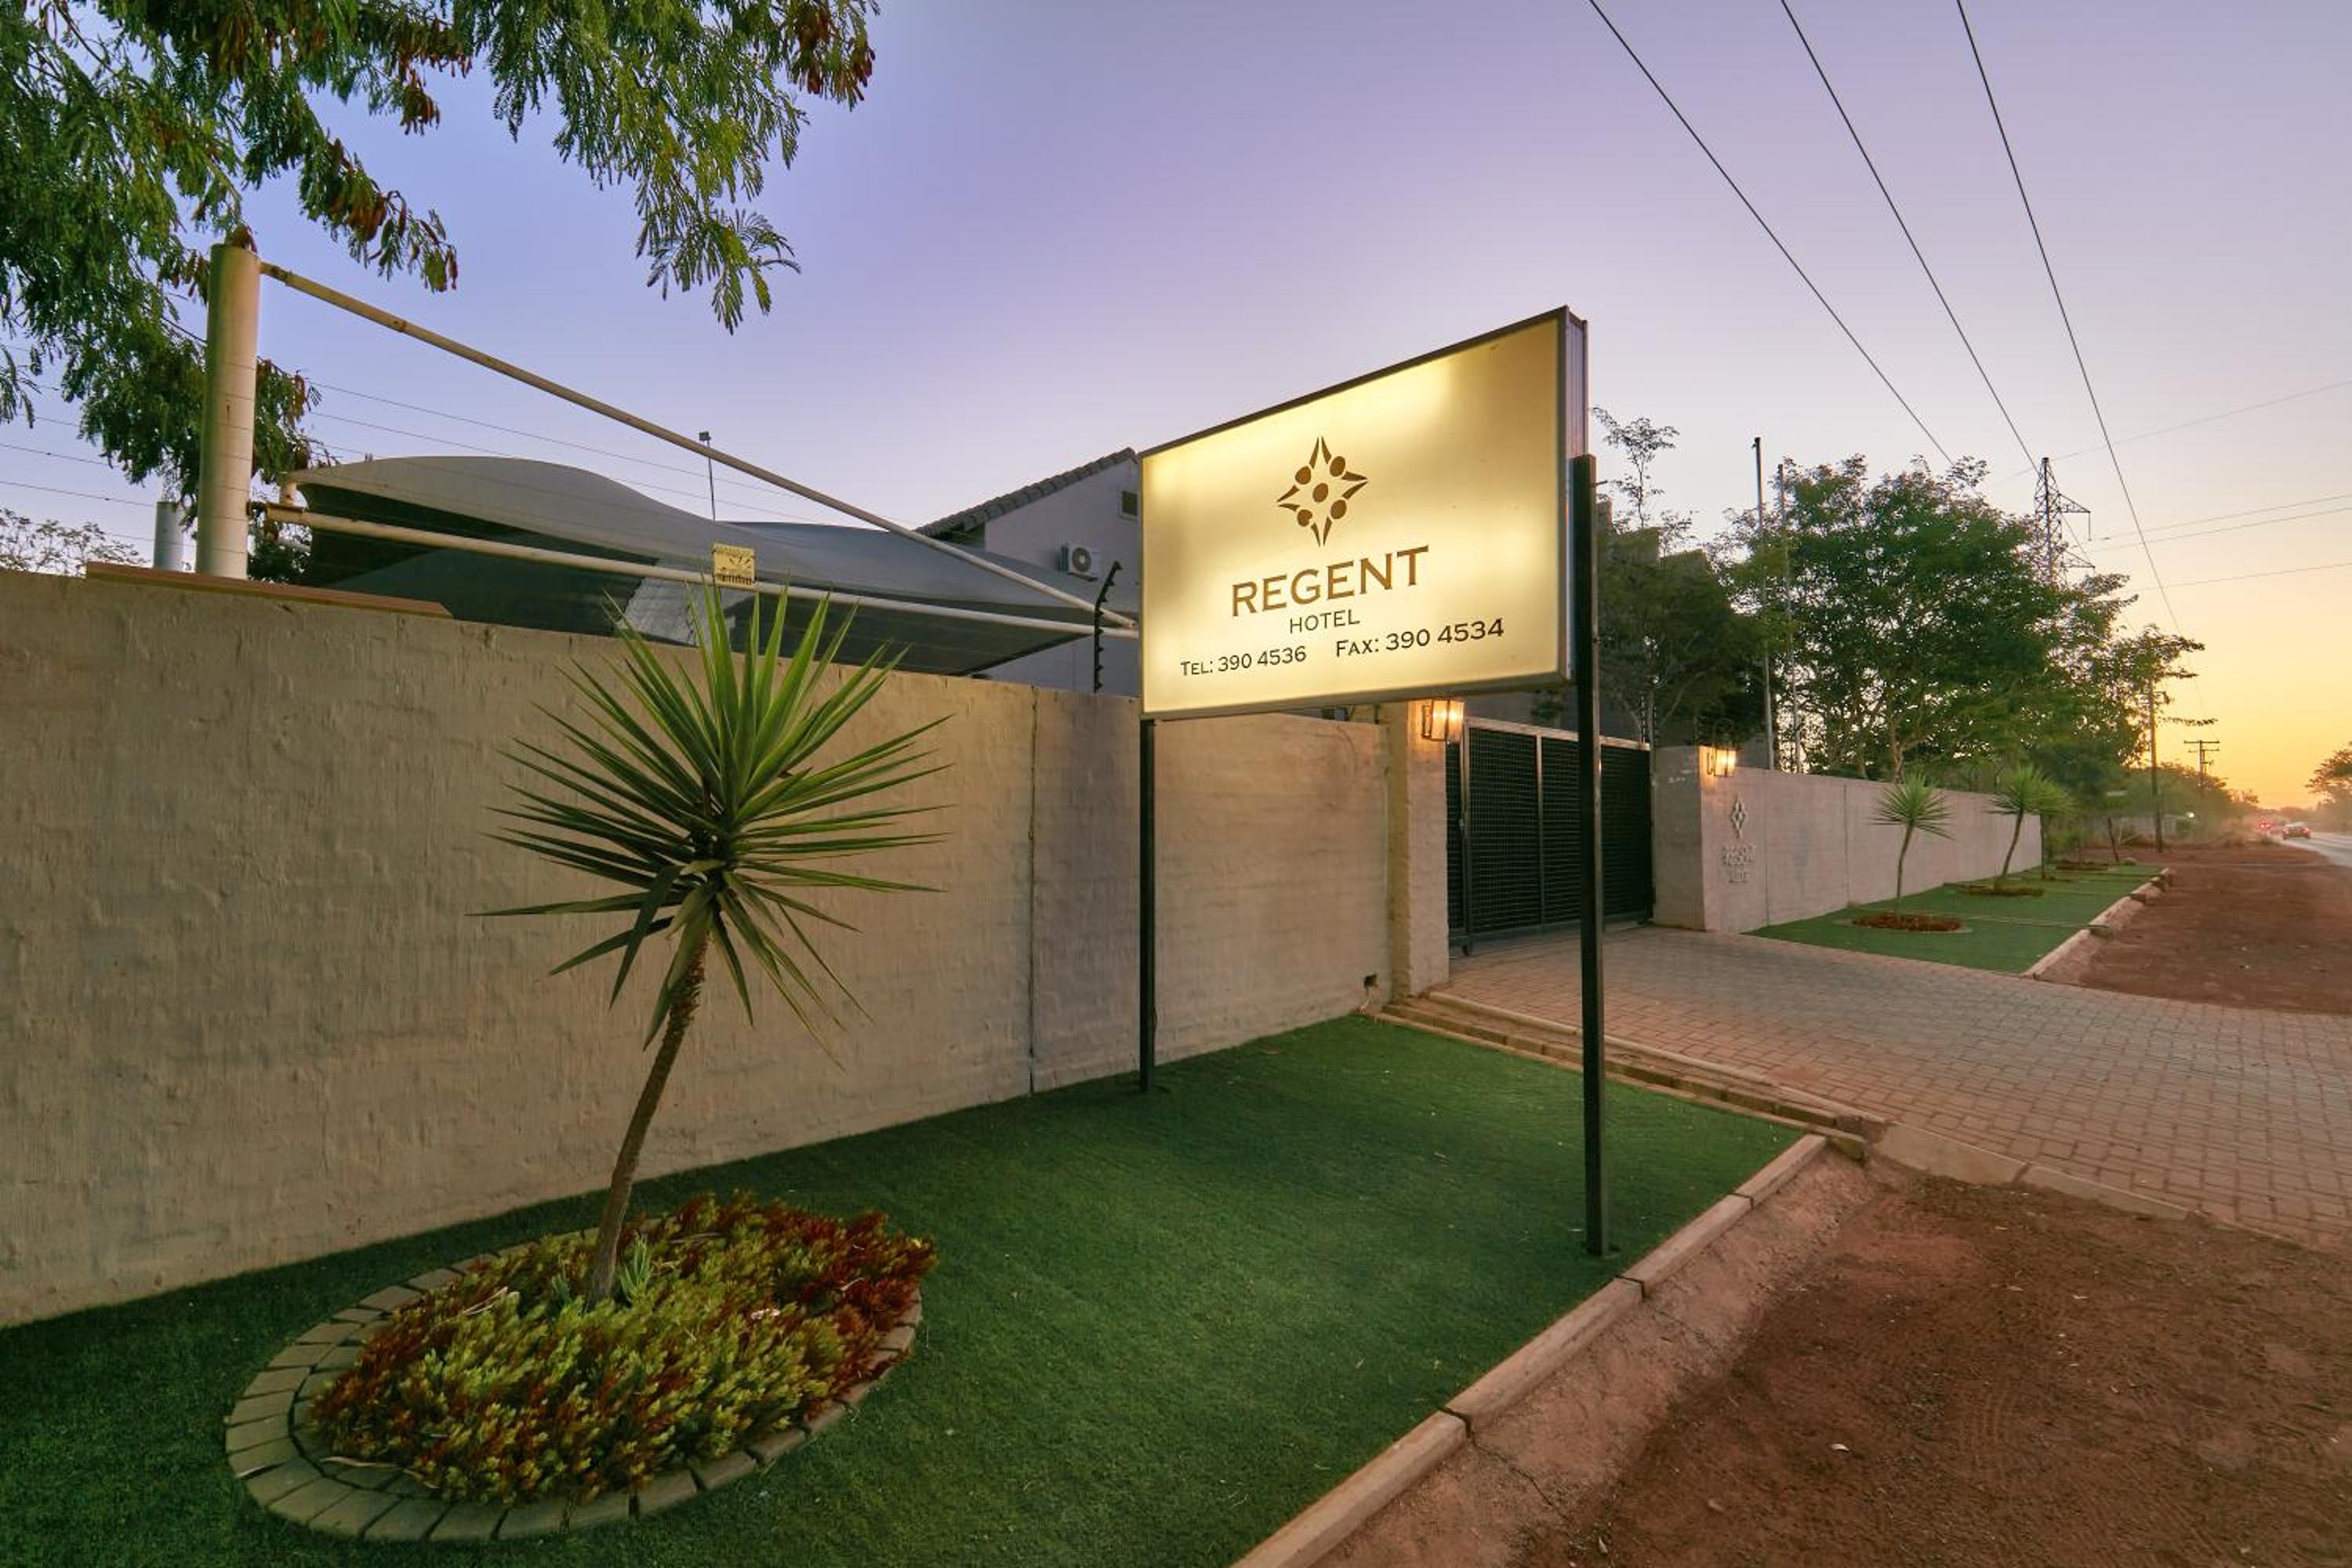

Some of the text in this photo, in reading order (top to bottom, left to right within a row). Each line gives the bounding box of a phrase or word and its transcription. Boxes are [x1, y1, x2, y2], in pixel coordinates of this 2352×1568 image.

[1231, 544, 1429, 617] REGENT
[1218, 652, 1252, 673] 390
[1257, 645, 1307, 666] 4536
[1385, 629, 1431, 652] 390
[1437, 617, 1504, 644] 4534
[1289, 608, 1361, 634] HOTEL
